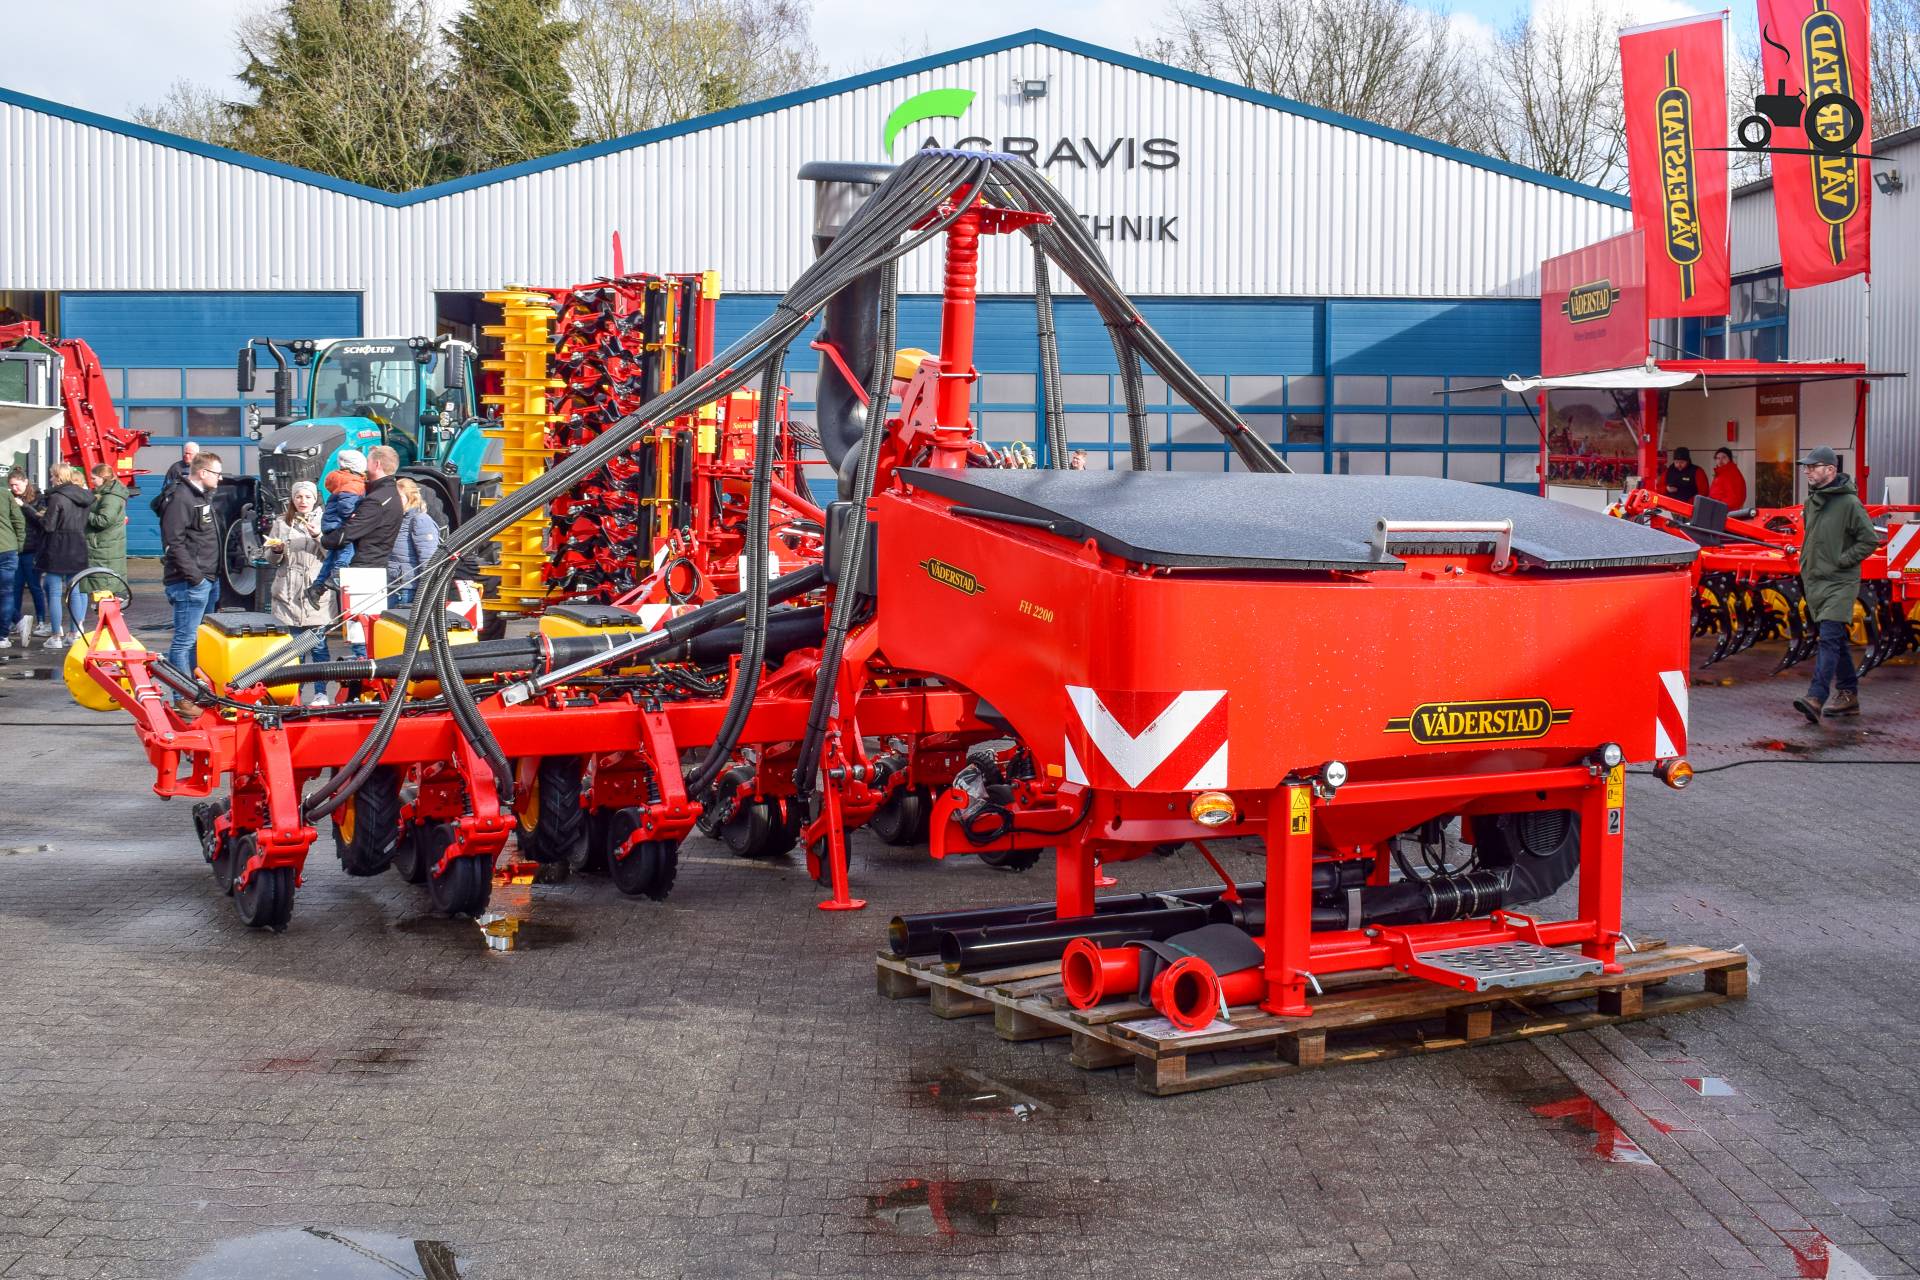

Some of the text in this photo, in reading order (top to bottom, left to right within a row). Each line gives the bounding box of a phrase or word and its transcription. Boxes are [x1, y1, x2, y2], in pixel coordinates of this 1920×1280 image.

[1078, 215, 1178, 241] HNIK
[931, 560, 974, 591] VÄDERSTAD
[1019, 600, 1054, 623] FH 2200
[1422, 706, 1543, 737] VÄDERSTAD
[1610, 810, 1619, 829] 2
